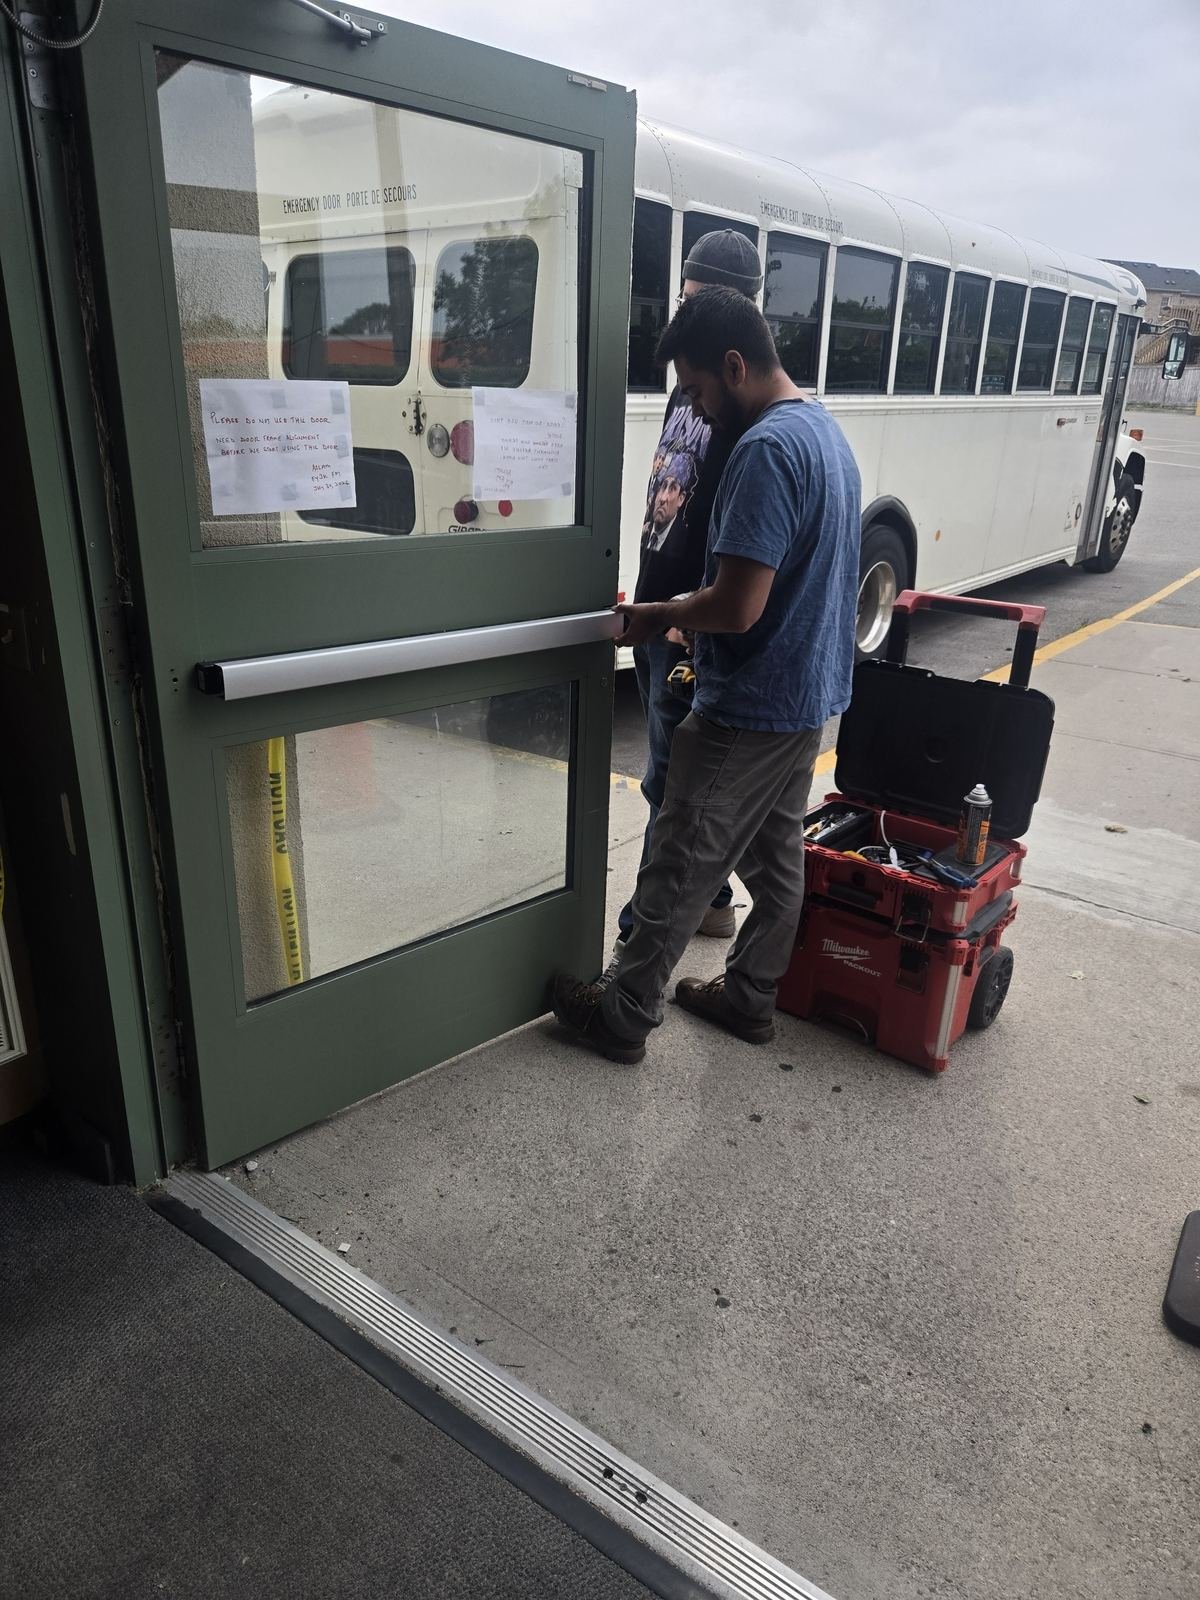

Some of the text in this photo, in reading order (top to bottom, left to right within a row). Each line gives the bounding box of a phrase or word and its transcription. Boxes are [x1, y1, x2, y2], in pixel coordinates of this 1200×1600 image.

[282, 184, 417, 214] EMERGENCY DOOR PORTE DE SECOURS
[760, 201, 788, 220] EMERGENCY
[789, 209, 799, 224] EXIT
[802, 212, 817, 228] SORTIE
[818, 216, 824, 230] DE
[210, 412, 239, 424] PLEASE
[258, 416, 270, 424] NOT
[221, 448, 246, 456] BEFORE
[821, 938, 870, 956] Milwaukee
[843, 960, 882, 976] PACKOUT
